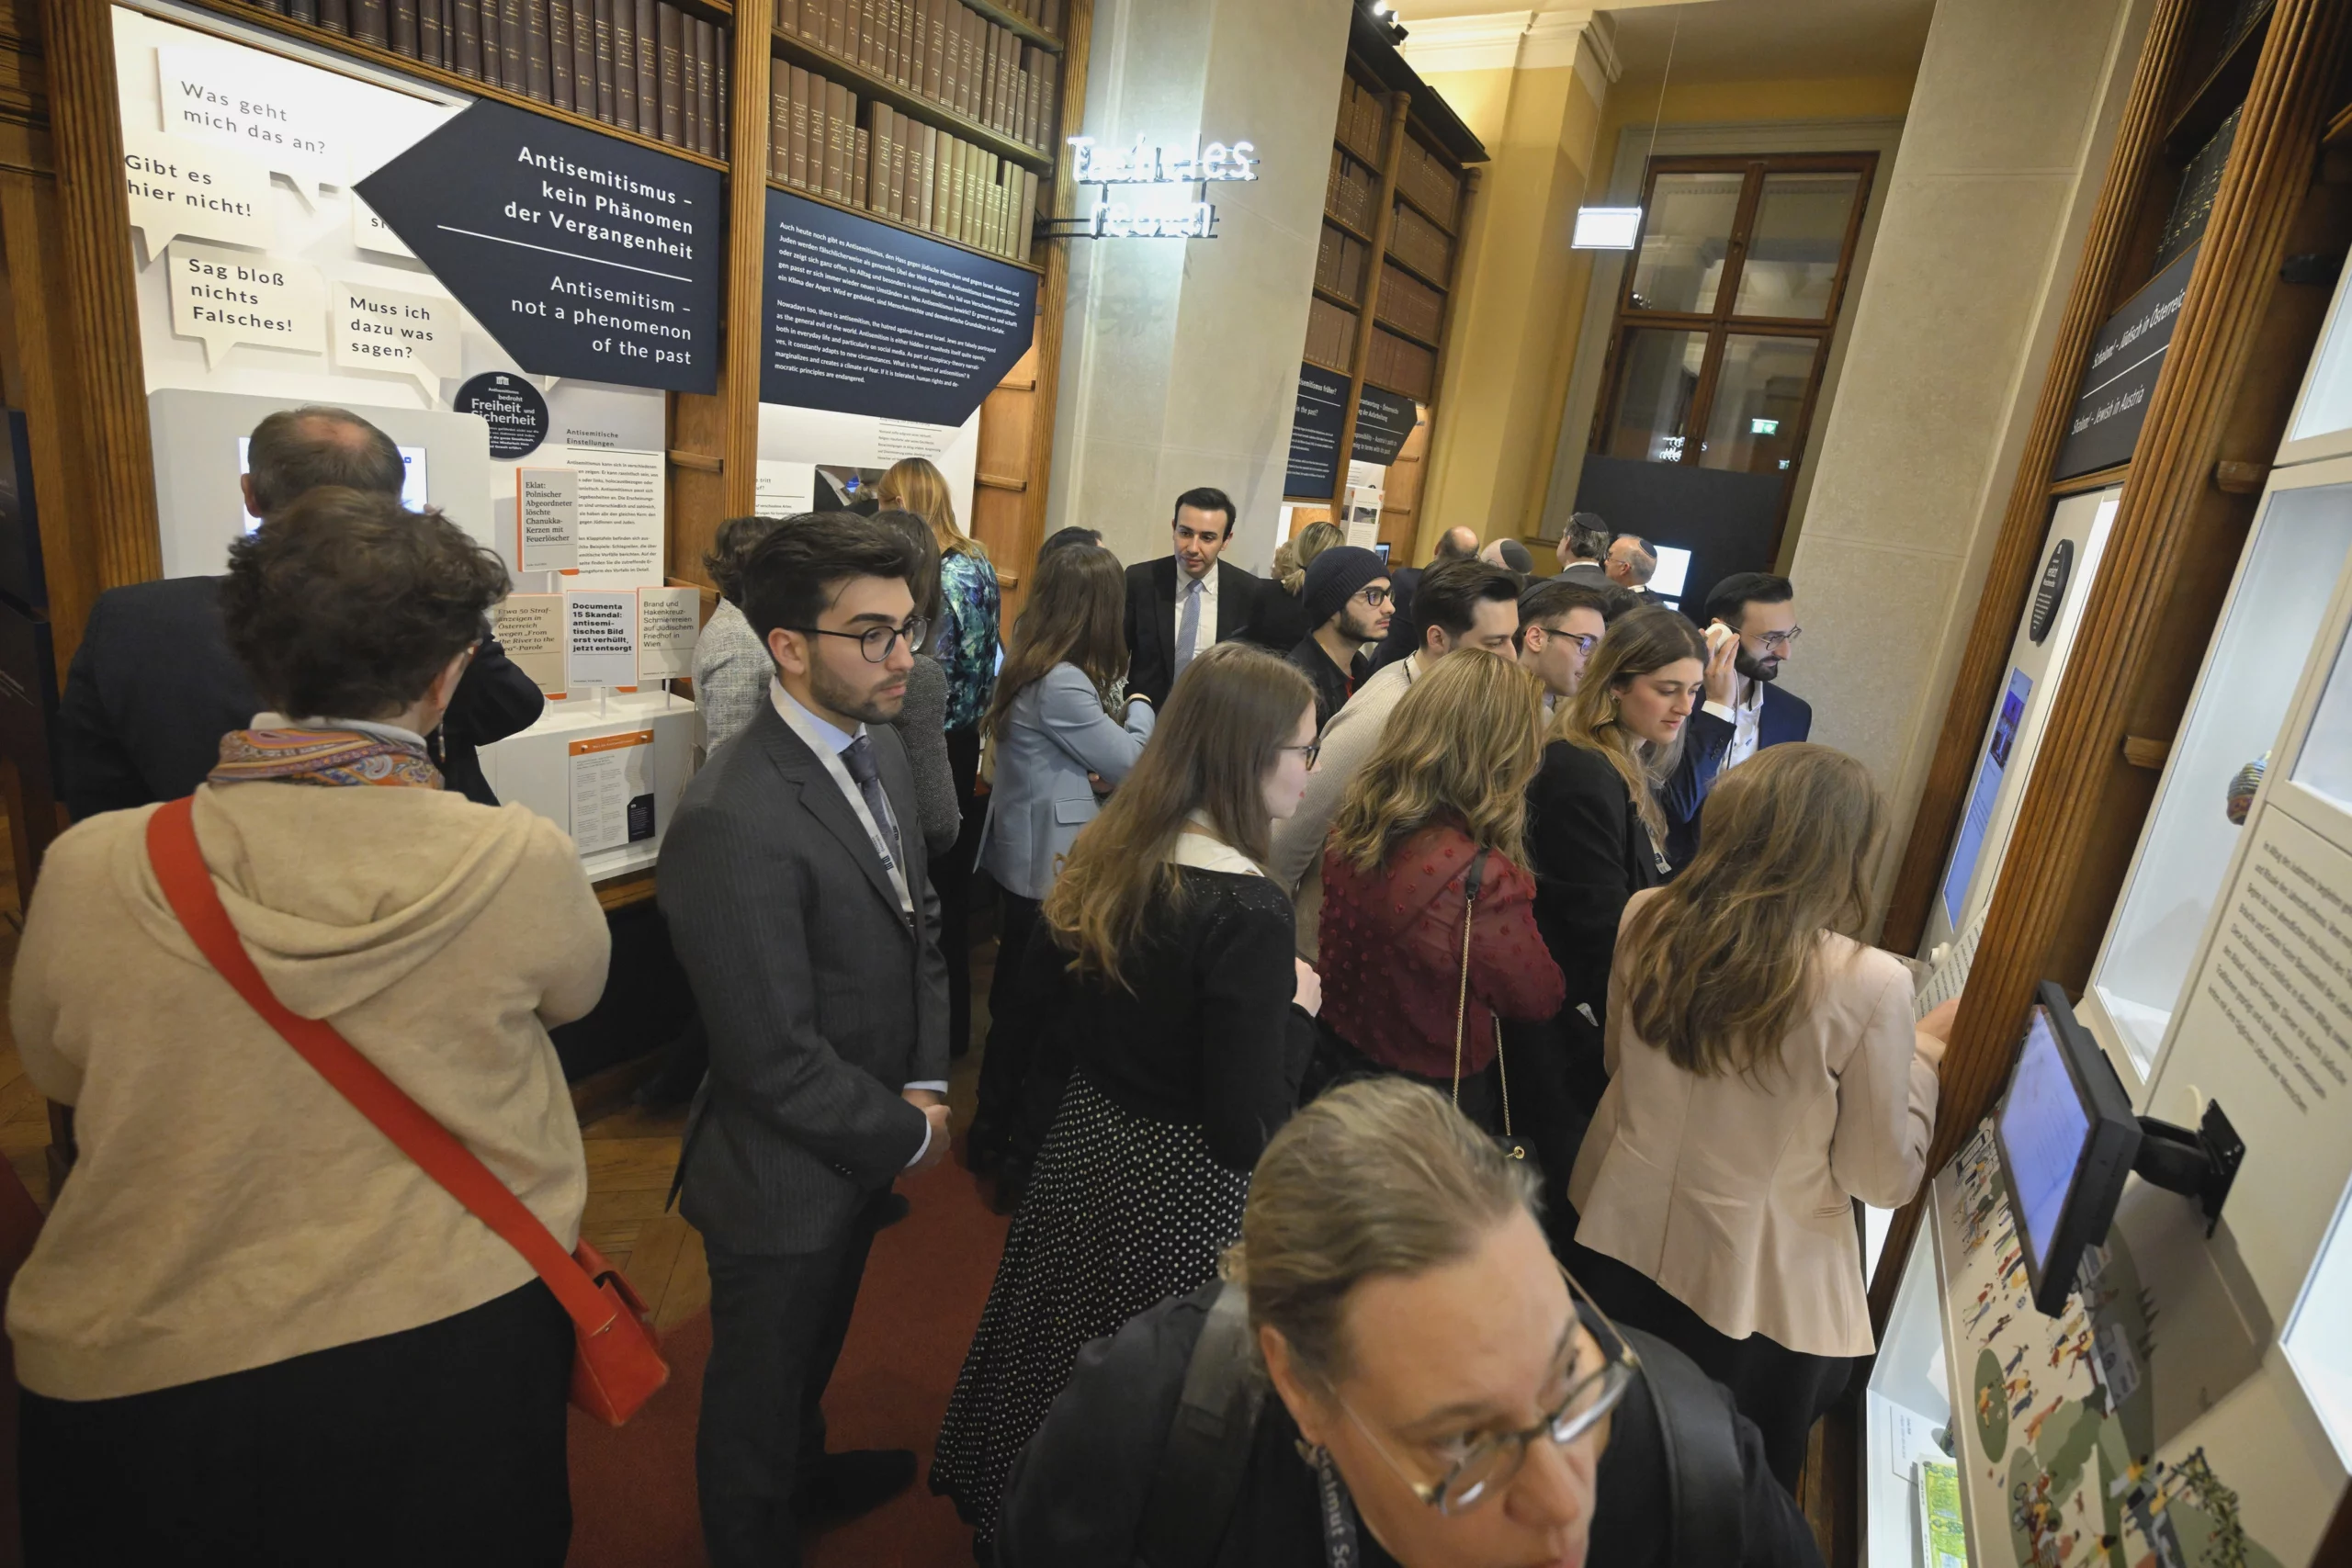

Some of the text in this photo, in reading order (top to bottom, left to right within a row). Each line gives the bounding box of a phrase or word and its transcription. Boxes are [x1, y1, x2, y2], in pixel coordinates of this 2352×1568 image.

[181, 81, 288, 121] Was geht
[184, 109, 325, 154] mich das an?
[125, 154, 212, 185] Gibt es
[518, 146, 675, 204] Antisemitismus
[128, 180, 252, 217] hier nicht!
[542, 181, 692, 234] kein Phänomen
[505, 202, 692, 259] der Vergangenheit
[779, 221, 794, 231] Auch
[795, 226, 812, 236] heute
[813, 231, 826, 240] noch
[827, 235, 837, 245] gibt
[845, 241, 884, 257] Antisemitismus,
[895, 255, 906, 263] Hass
[907, 260, 920, 269] gegen
[921, 263, 939, 274] jüdische
[939, 269, 961, 279] Menschen
[970, 279, 982, 287] gegen
[994, 285, 1011, 294] Jüdinnen
[189, 259, 285, 287] Sag bloß
[191, 285, 258, 305] nichts
[551, 276, 674, 312] Antisemitism
[193, 307, 292, 332] Falsches!
[350, 297, 430, 321] Muss ich
[512, 299, 691, 341] not a phenomenon
[351, 320, 433, 341] dazu was
[776, 299, 805, 312] Nowadays
[818, 308, 832, 317] there
[839, 313, 871, 326] antisemitism,
[880, 322, 896, 331] hatred
[896, 326, 912, 335] against
[977, 344, 996, 353] portrayed
[2119, 319, 2143, 351] Jüdisch
[2141, 315, 2150, 334] in
[351, 342, 413, 358] sagen?
[593, 339, 691, 365] of the past
[774, 362, 798, 372] mocratic
[799, 366, 825, 377] principles
[835, 372, 865, 383] endangered.
[471, 399, 521, 412] Freiheit
[2119, 384, 2144, 412] Austria
[566, 429, 619, 438] Antisemitische
[566, 438, 614, 447] Einstellungen
